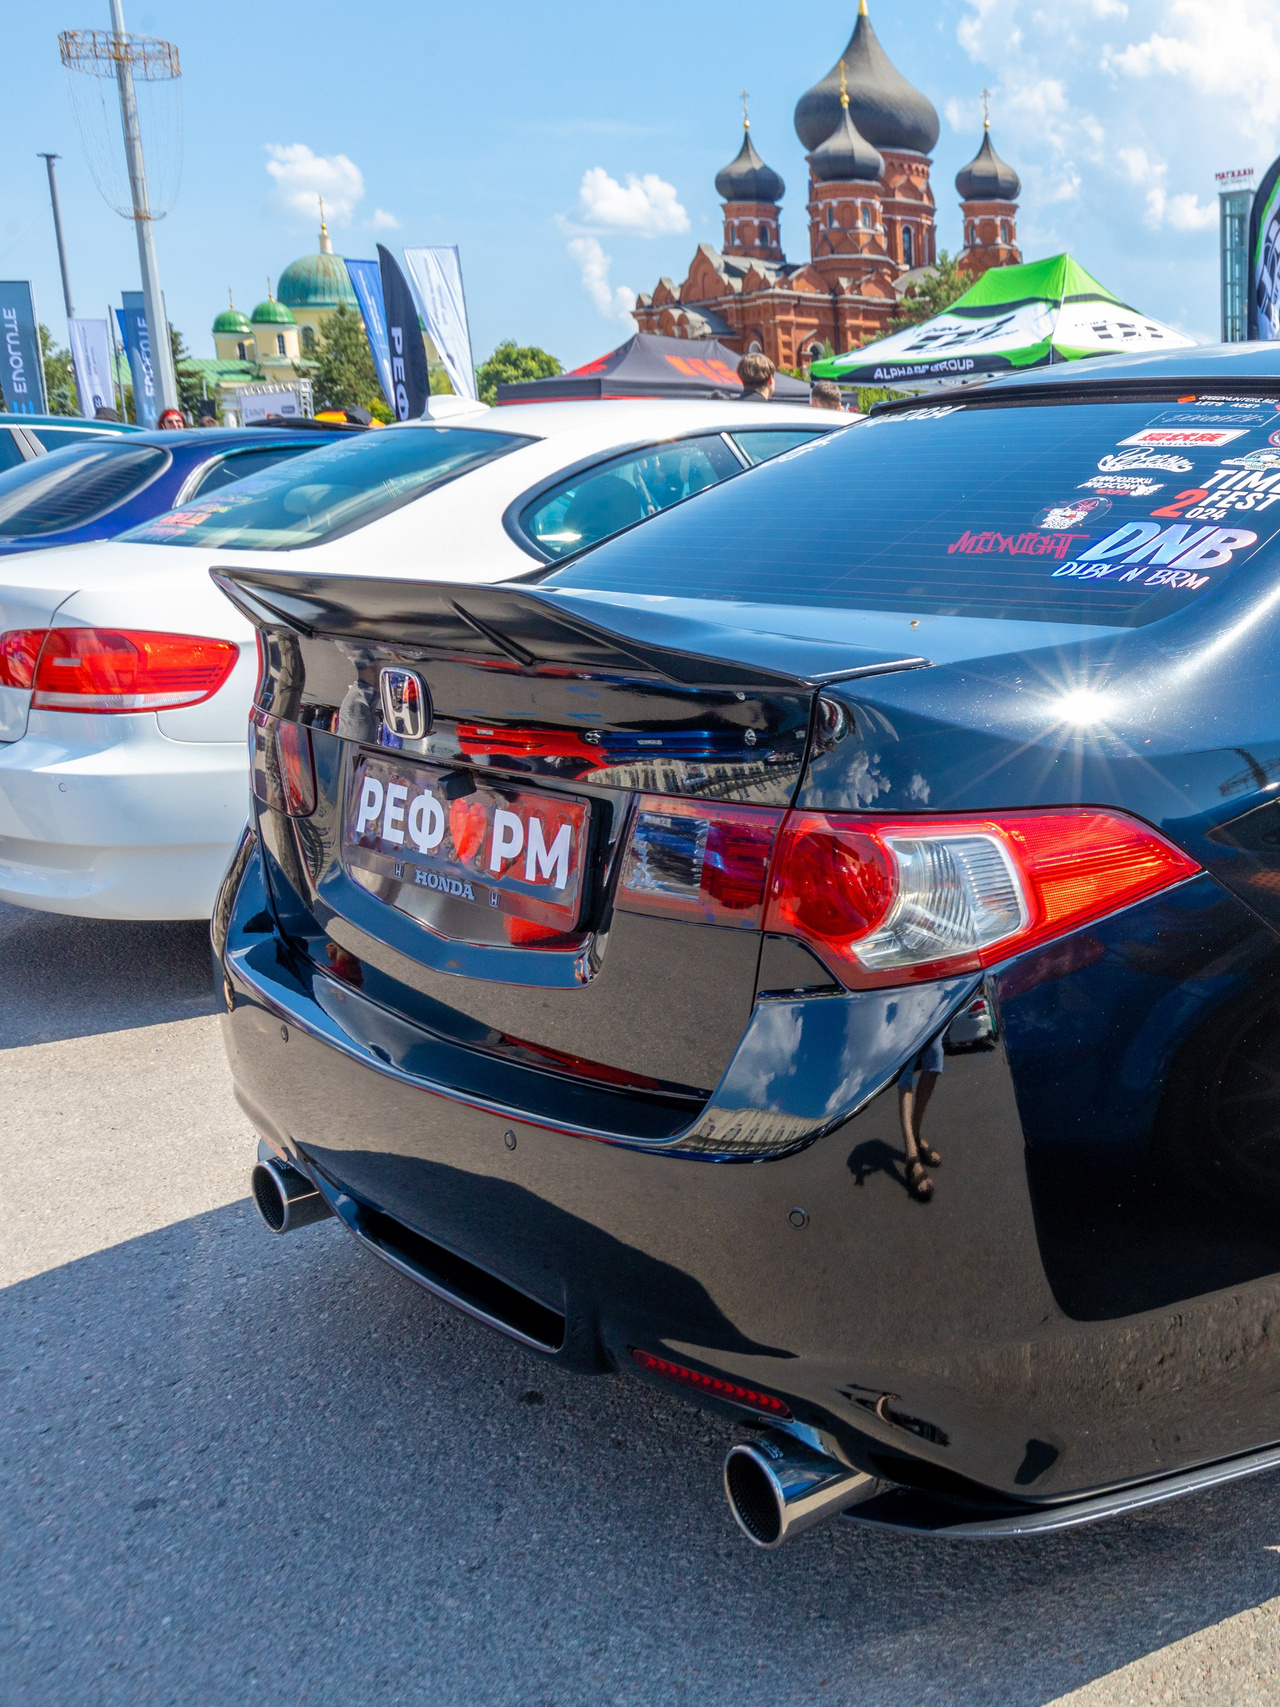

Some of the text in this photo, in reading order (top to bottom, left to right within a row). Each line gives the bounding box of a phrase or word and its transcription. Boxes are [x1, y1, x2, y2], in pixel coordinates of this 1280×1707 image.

[947, 529, 1091, 560] MIDNIGHT
[1076, 520, 1259, 570] DNB
[1144, 569, 1211, 591] BRM
[414, 868, 476, 901] HONDA
